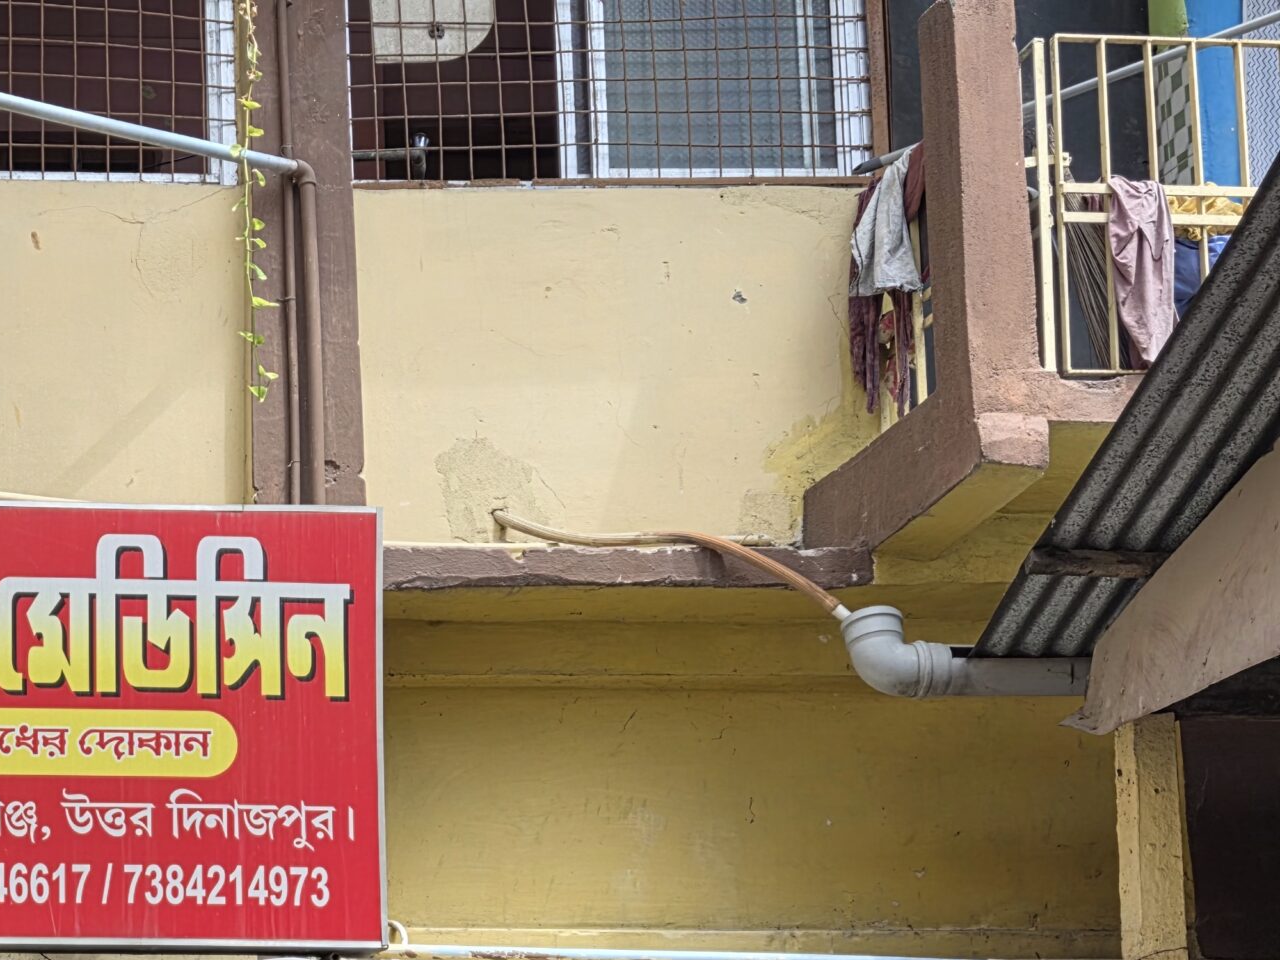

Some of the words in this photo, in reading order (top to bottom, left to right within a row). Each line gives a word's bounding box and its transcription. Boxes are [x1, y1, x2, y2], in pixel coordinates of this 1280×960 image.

[78, 728, 212, 760] দোকান
[60, 788, 156, 837] উত্তর
[123, 862, 330, 908] 7384214973
